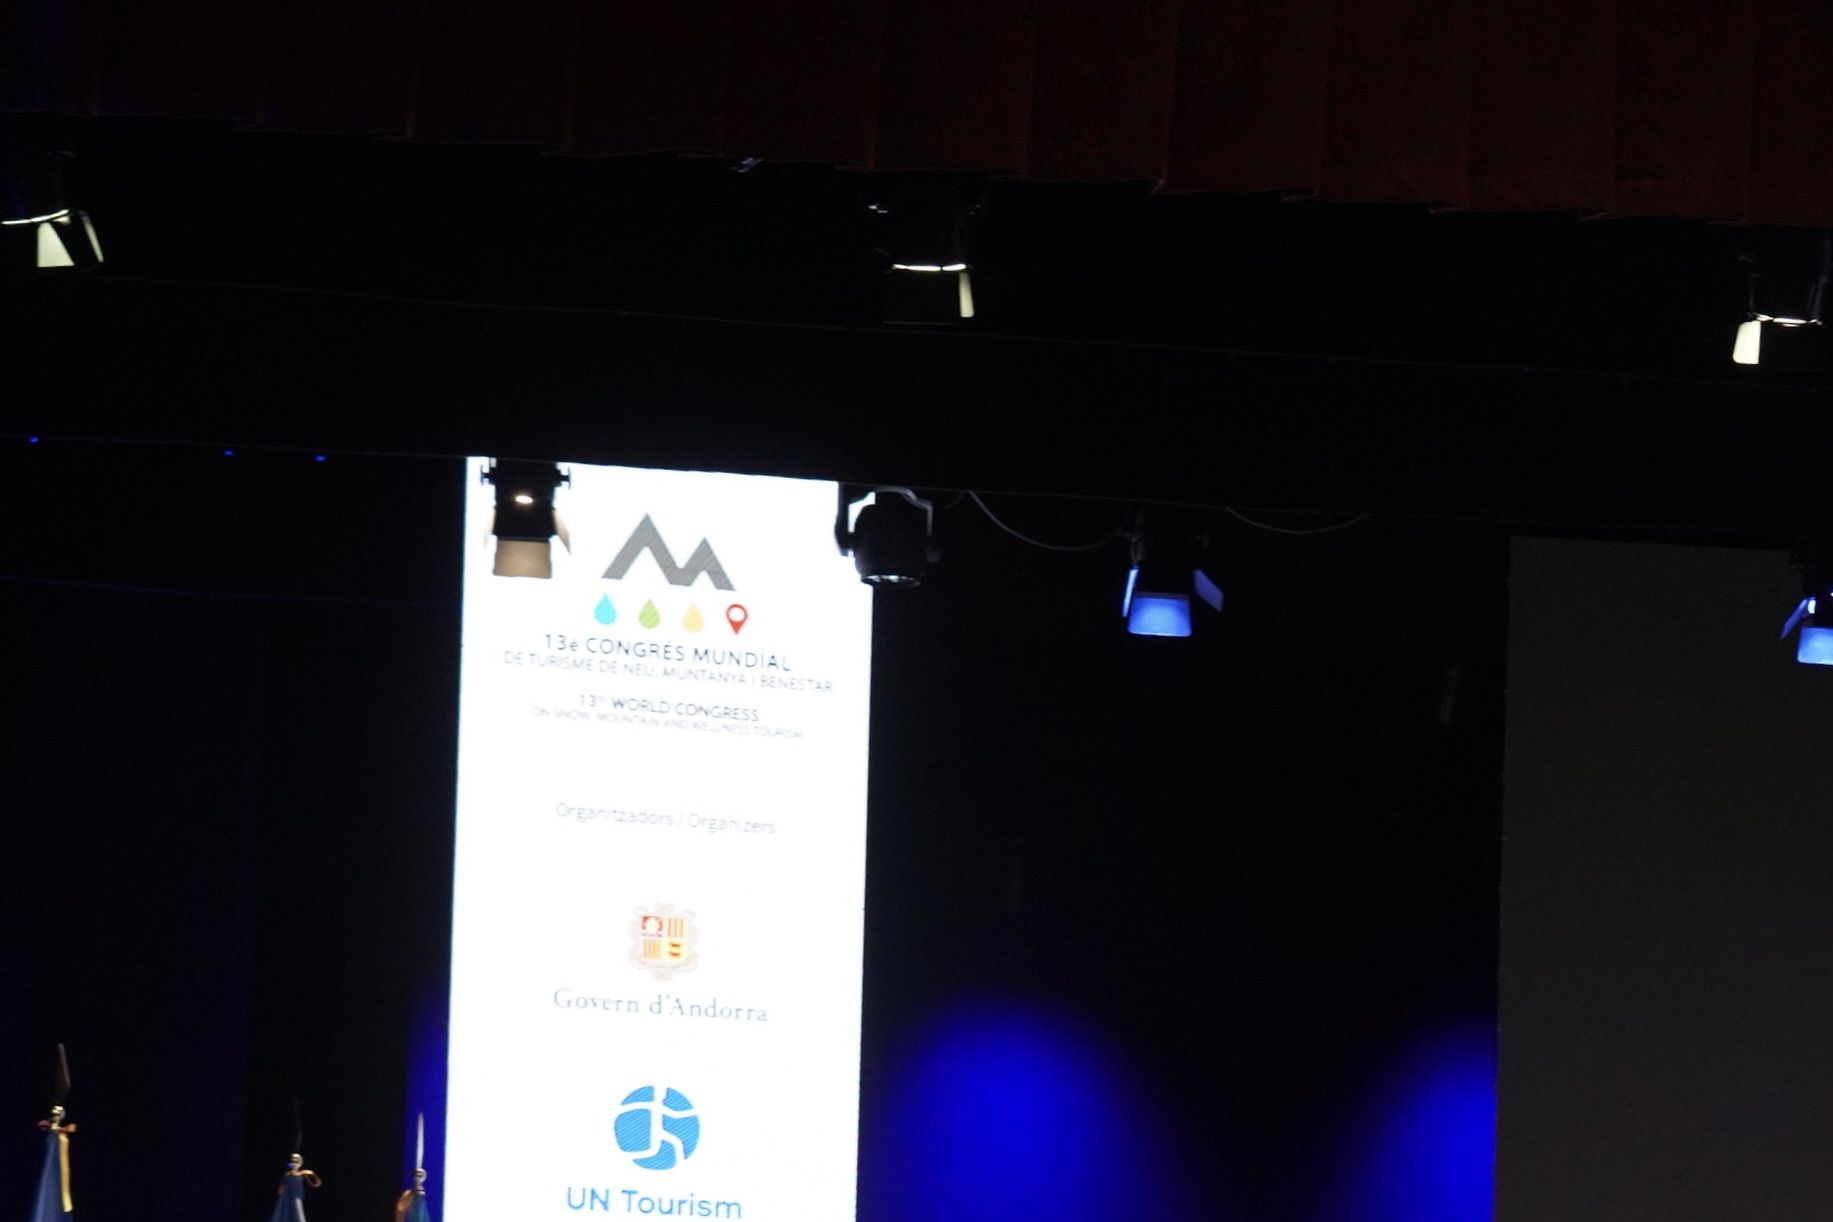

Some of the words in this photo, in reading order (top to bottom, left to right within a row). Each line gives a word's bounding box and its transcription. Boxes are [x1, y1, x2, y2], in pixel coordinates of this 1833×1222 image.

[504, 650, 524, 666] DE
[529, 652, 594, 672] TURISME
[600, 660, 618, 674] DE
[663, 666, 747, 683] MUNTANYA
[760, 675, 833, 693] BENESTAR
[692, 647, 792, 672] MUNDIAL
[612, 697, 672, 714] WORLD
[675, 701, 760, 722] CONGRESS
[555, 801, 674, 827] Organitzadors
[553, 987, 640, 1014] Govern
[567, 1186, 610, 1212] UN
[621, 1188, 742, 1219] Tourism
